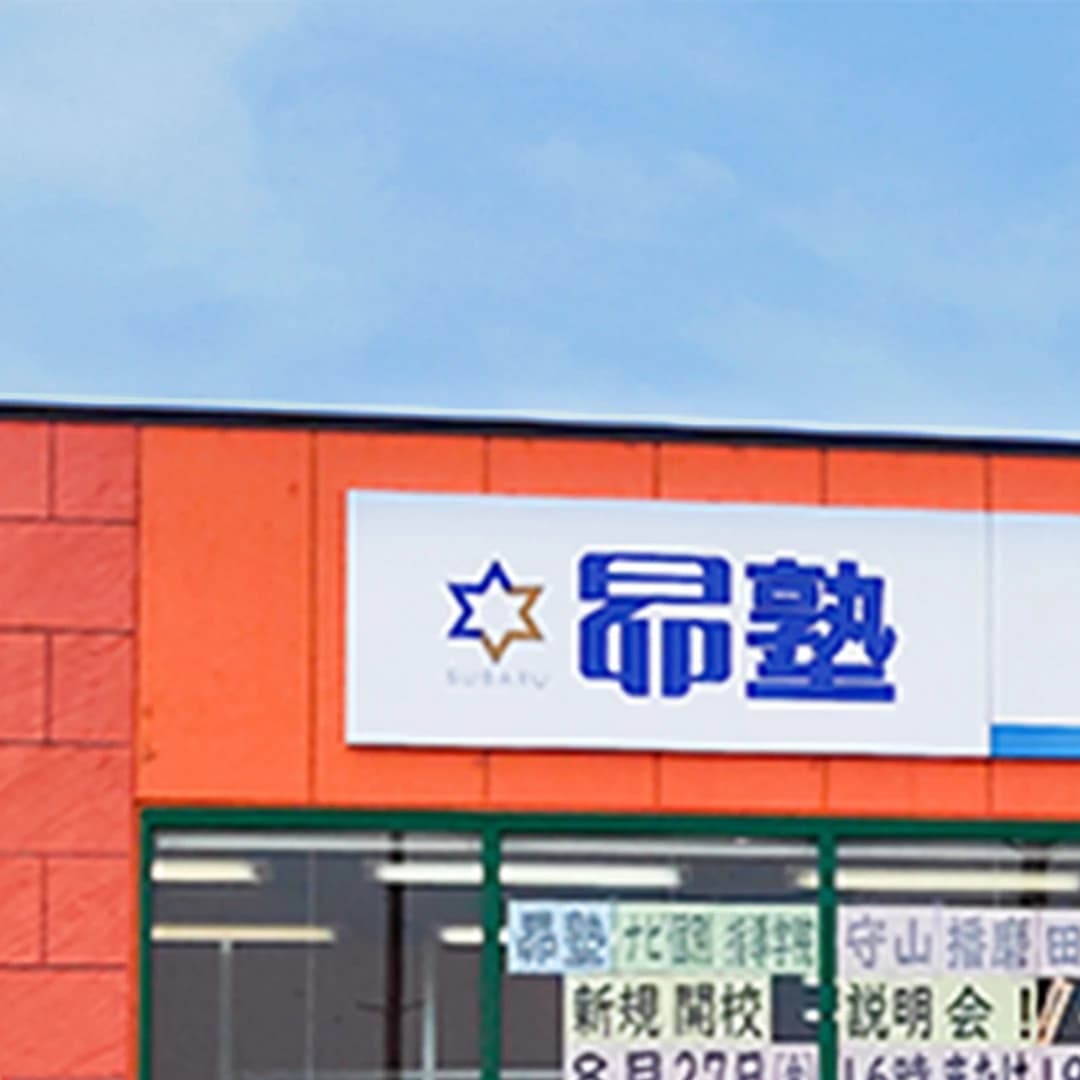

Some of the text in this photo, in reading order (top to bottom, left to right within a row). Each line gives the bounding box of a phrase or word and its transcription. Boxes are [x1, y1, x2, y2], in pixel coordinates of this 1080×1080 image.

[577, 551, 898, 701] 昴塾
[573, 982, 763, 1039] 新規開校
